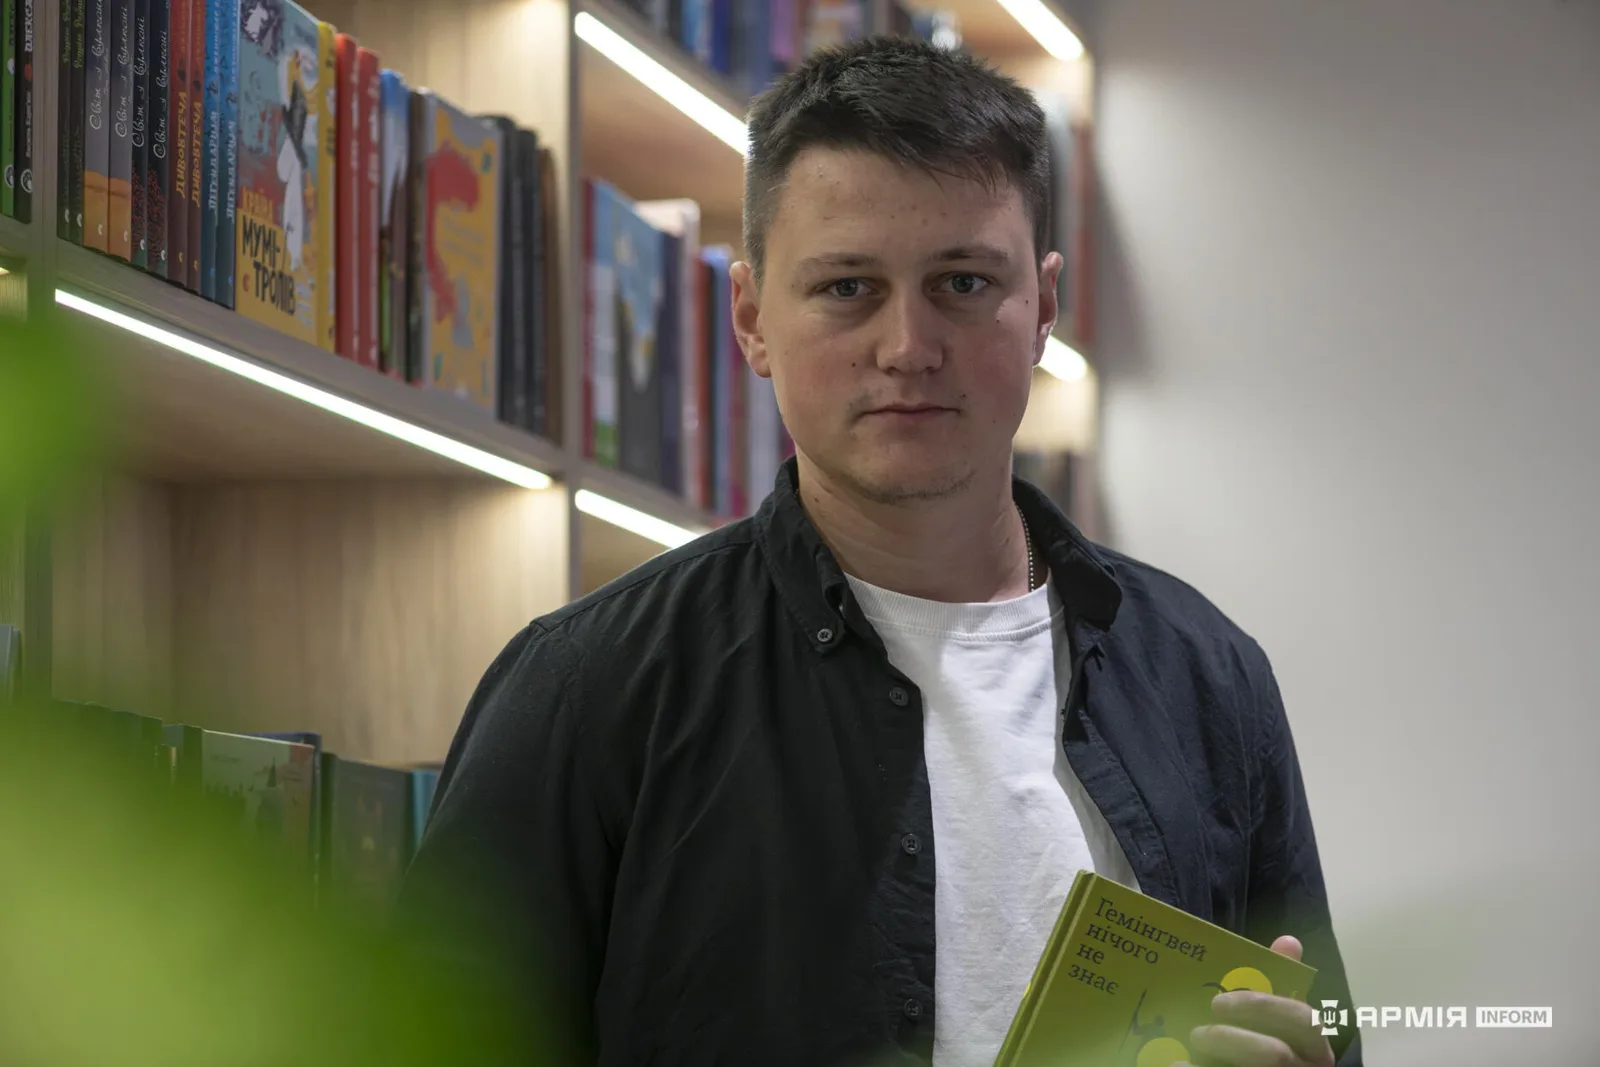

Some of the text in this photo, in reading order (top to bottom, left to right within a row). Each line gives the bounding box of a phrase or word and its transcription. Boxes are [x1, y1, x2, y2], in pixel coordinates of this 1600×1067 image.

[176, 91, 188, 200] ДИВОВТЕЧА
[191, 102, 202, 208] ДИВОВТЕЧА
[253, 260, 296, 316] ТРОЛІВ
[1076, 943, 1106, 965] не
[1085, 924, 1159, 964] нічого
[1067, 964, 1119, 995] знає
